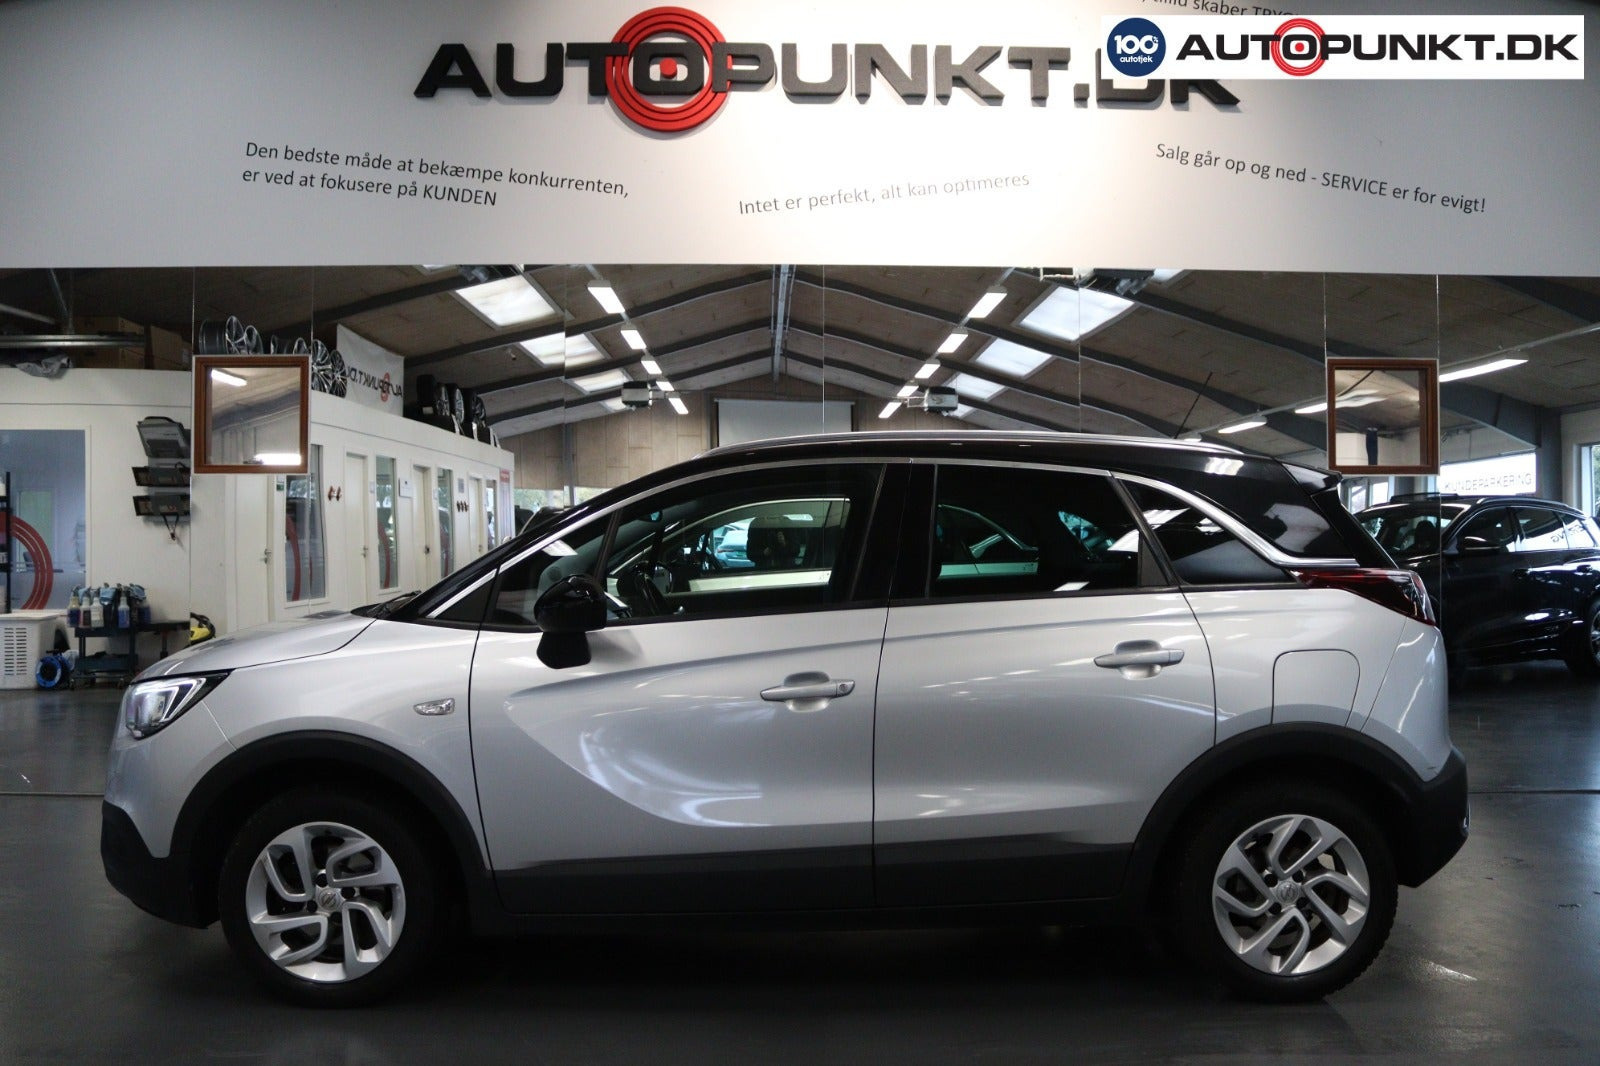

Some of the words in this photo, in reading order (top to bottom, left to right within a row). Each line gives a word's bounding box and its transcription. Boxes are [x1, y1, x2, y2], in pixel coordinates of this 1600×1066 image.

[1193, 0, 1247, 15] skaber
[242, 170, 260, 183] er
[265, 170, 295, 186] ved
[299, 173, 316, 188] at
[320, 173, 392, 195] fokusere
[397, 181, 418, 198] på
[423, 184, 497, 207] KUNDEN
[245, 142, 279, 159] Den
[284, 145, 340, 165] bedste
[345, 151, 392, 170] måde
[397, 157, 415, 173] at
[419, 158, 504, 182] bekæmpe
[508, 168, 630, 198] konkurrenten,
[1156, 143, 1190, 165] Salg
[1194, 150, 1221, 167] går
[1225, 158, 1246, 174] op
[1250, 163, 1271, 180] og
[1276, 167, 1307, 183] ned
[1322, 172, 1388, 197] SERVICE
[1392, 187, 1409, 200] er
[1414, 187, 1437, 204] for
[1440, 195, 1486, 215] evigt!
[739, 197, 781, 215] Intet
[785, 197, 803, 210] er
[808, 188, 876, 212] perfekt,
[881, 184, 902, 200] alt
[907, 182, 938, 197] kan
[943, 173, 1031, 196] optimeres
